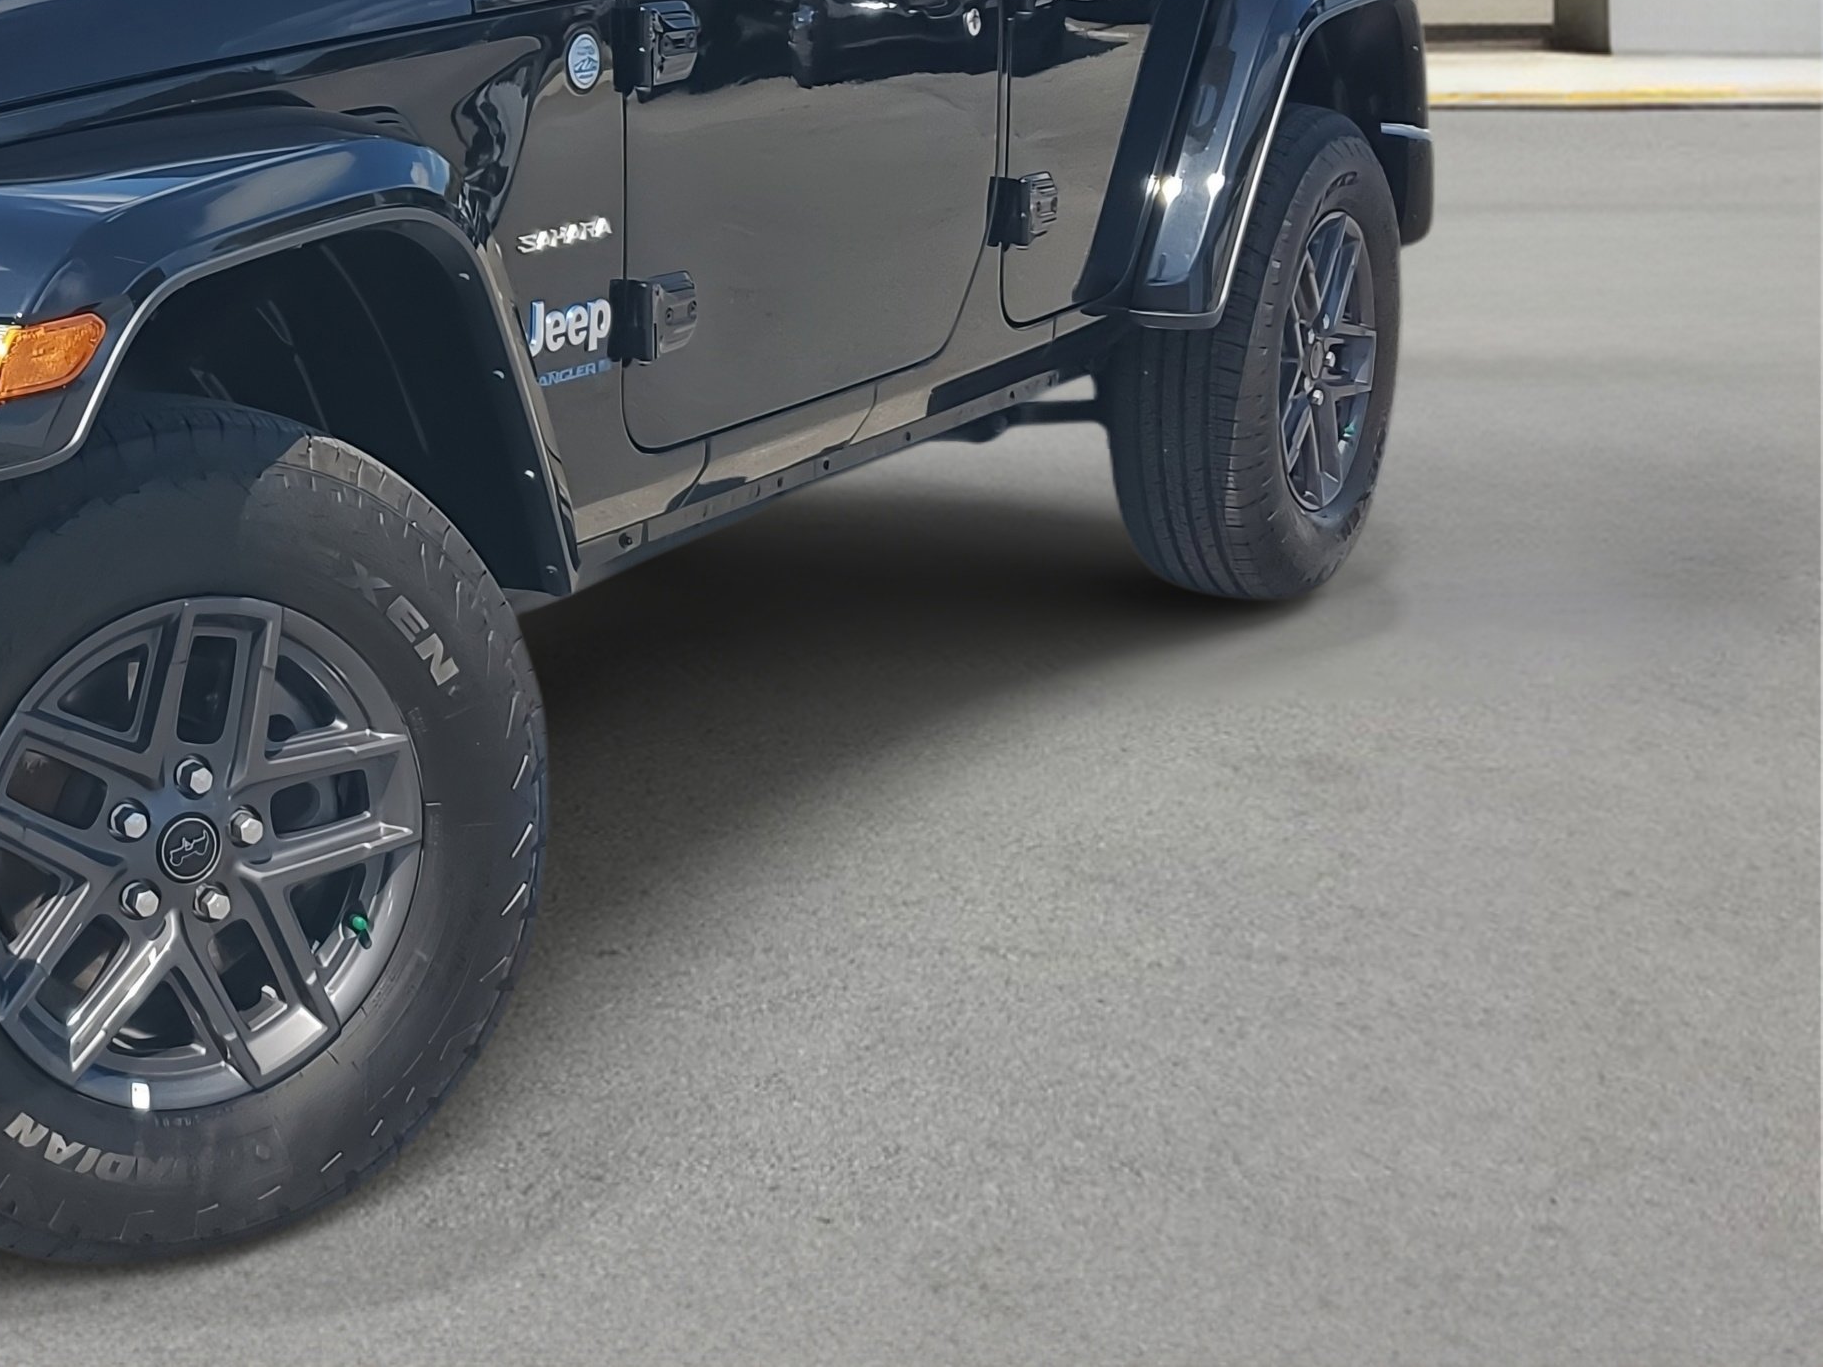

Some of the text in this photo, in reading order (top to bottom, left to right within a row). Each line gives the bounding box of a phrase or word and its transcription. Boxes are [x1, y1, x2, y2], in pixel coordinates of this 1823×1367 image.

[517, 217, 612, 253] SAHARA
[529, 298, 612, 358] Jeep
[538, 361, 597, 386] ANGLER
